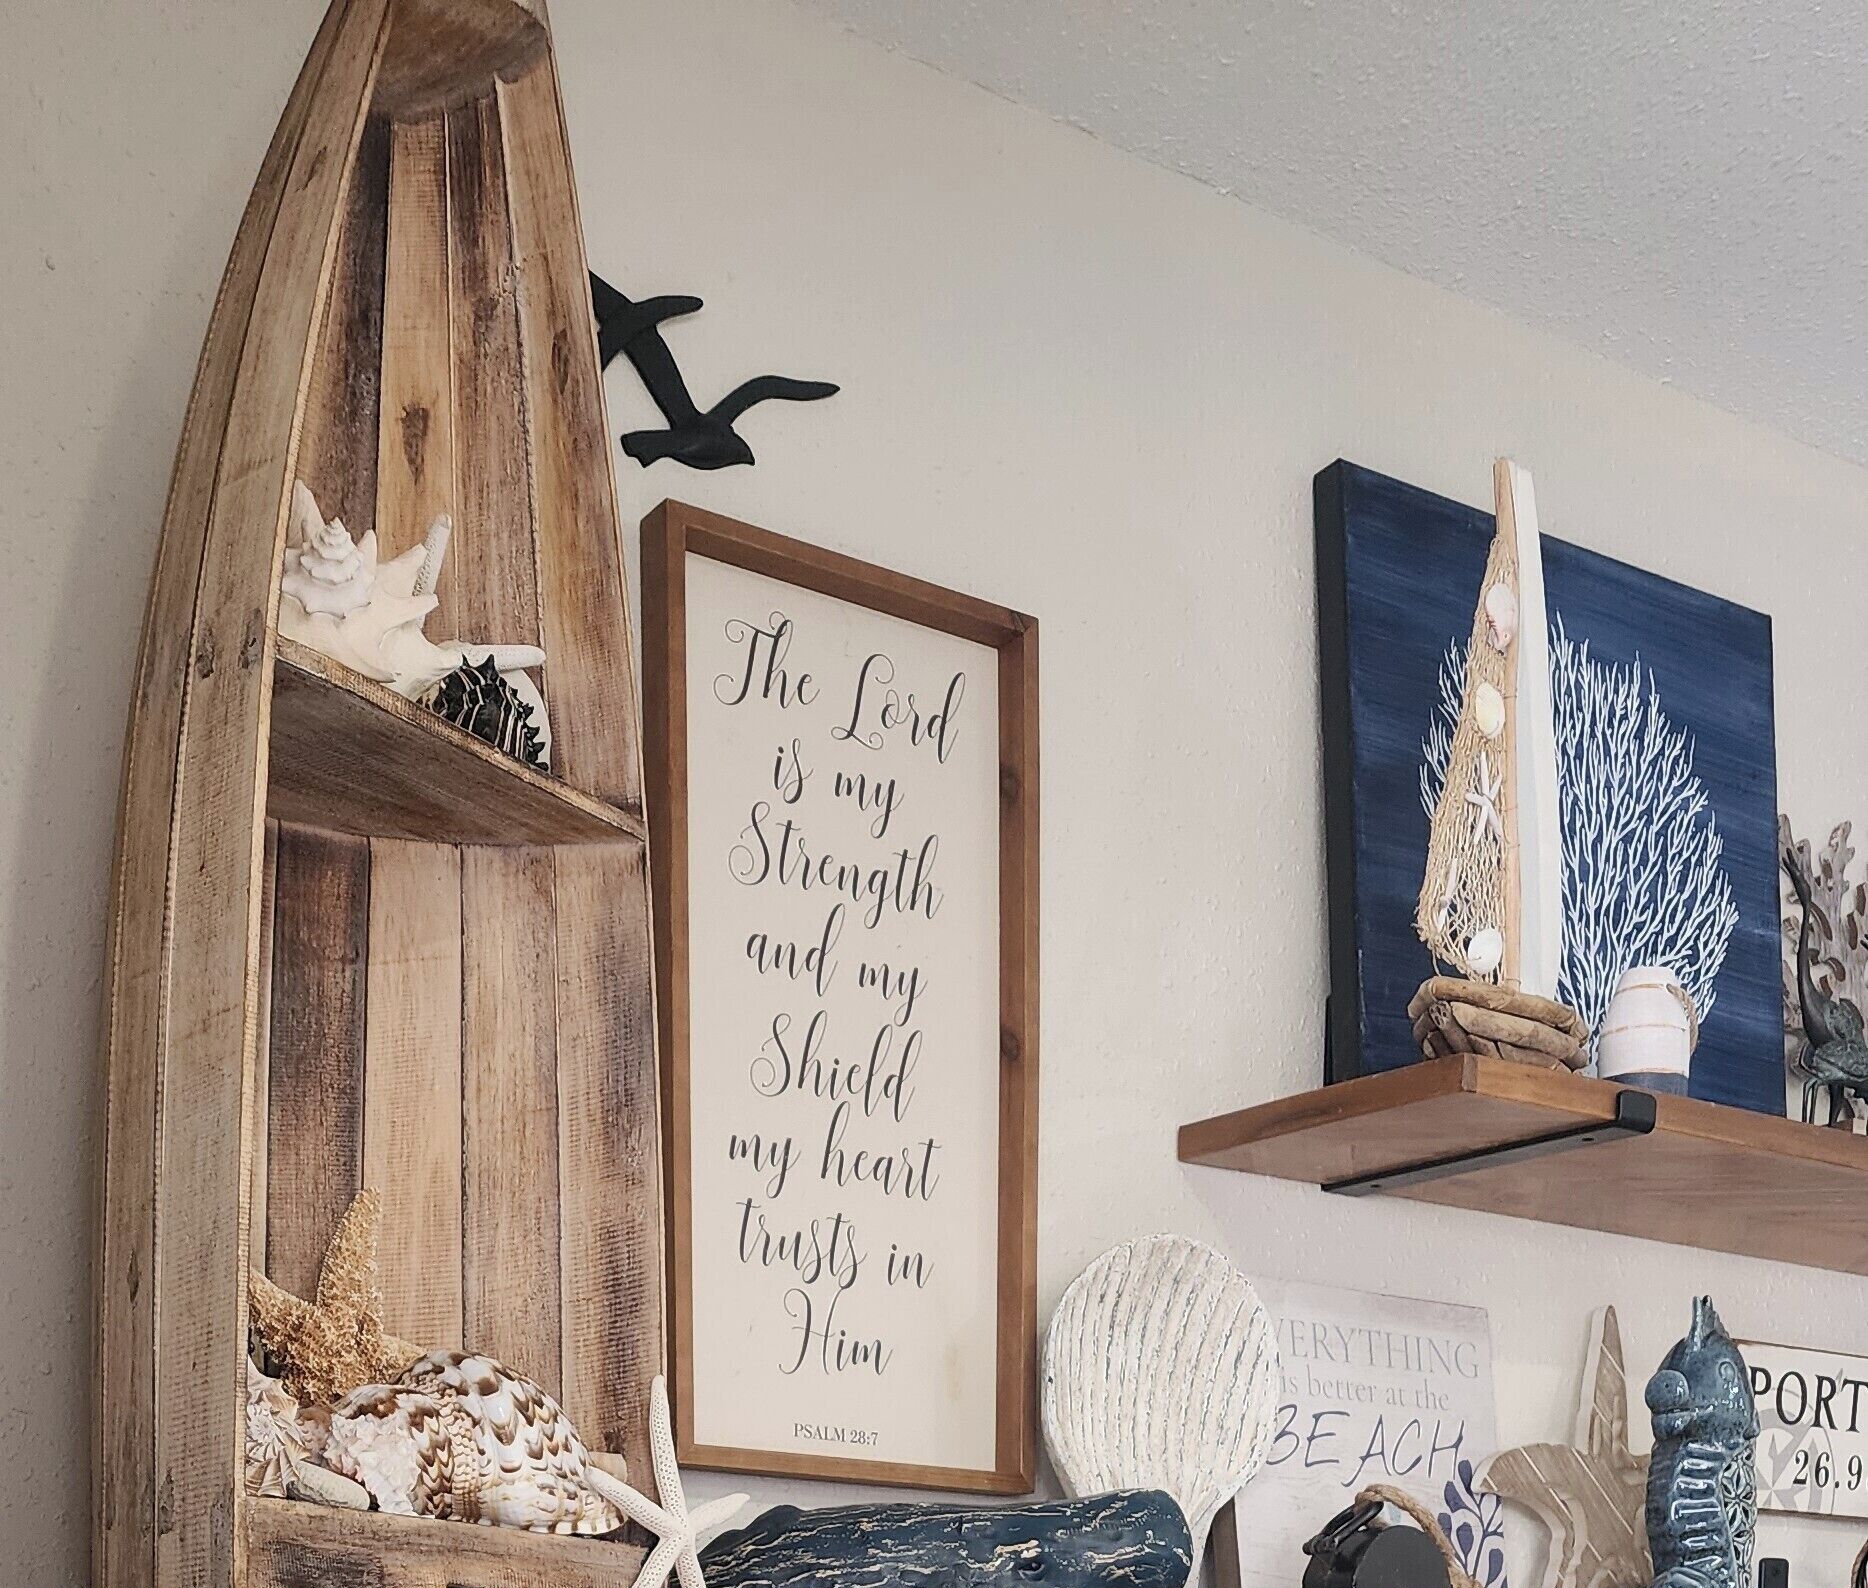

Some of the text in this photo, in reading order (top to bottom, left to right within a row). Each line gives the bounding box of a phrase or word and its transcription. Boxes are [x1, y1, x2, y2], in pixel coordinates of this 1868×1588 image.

[713, 610, 966, 764] The Lord
[773, 738, 905, 839] is my
[728, 801, 945, 929] Strength
[746, 903, 929, 1027] and my
[750, 1010, 923, 1123] Shield
[728, 1100, 943, 1202] my heart
[735, 1197, 934, 1290] trusts in
[778, 1287, 894, 1376] Him
[1281, 1364, 1450, 1411] is better at the
[1749, 1365, 1868, 1433] PORT
[793, 1423, 879, 1446] PSALM 28:7
[1266, 1403, 1465, 1488] BEACH
[1792, 1449, 1864, 1492] 26.9
